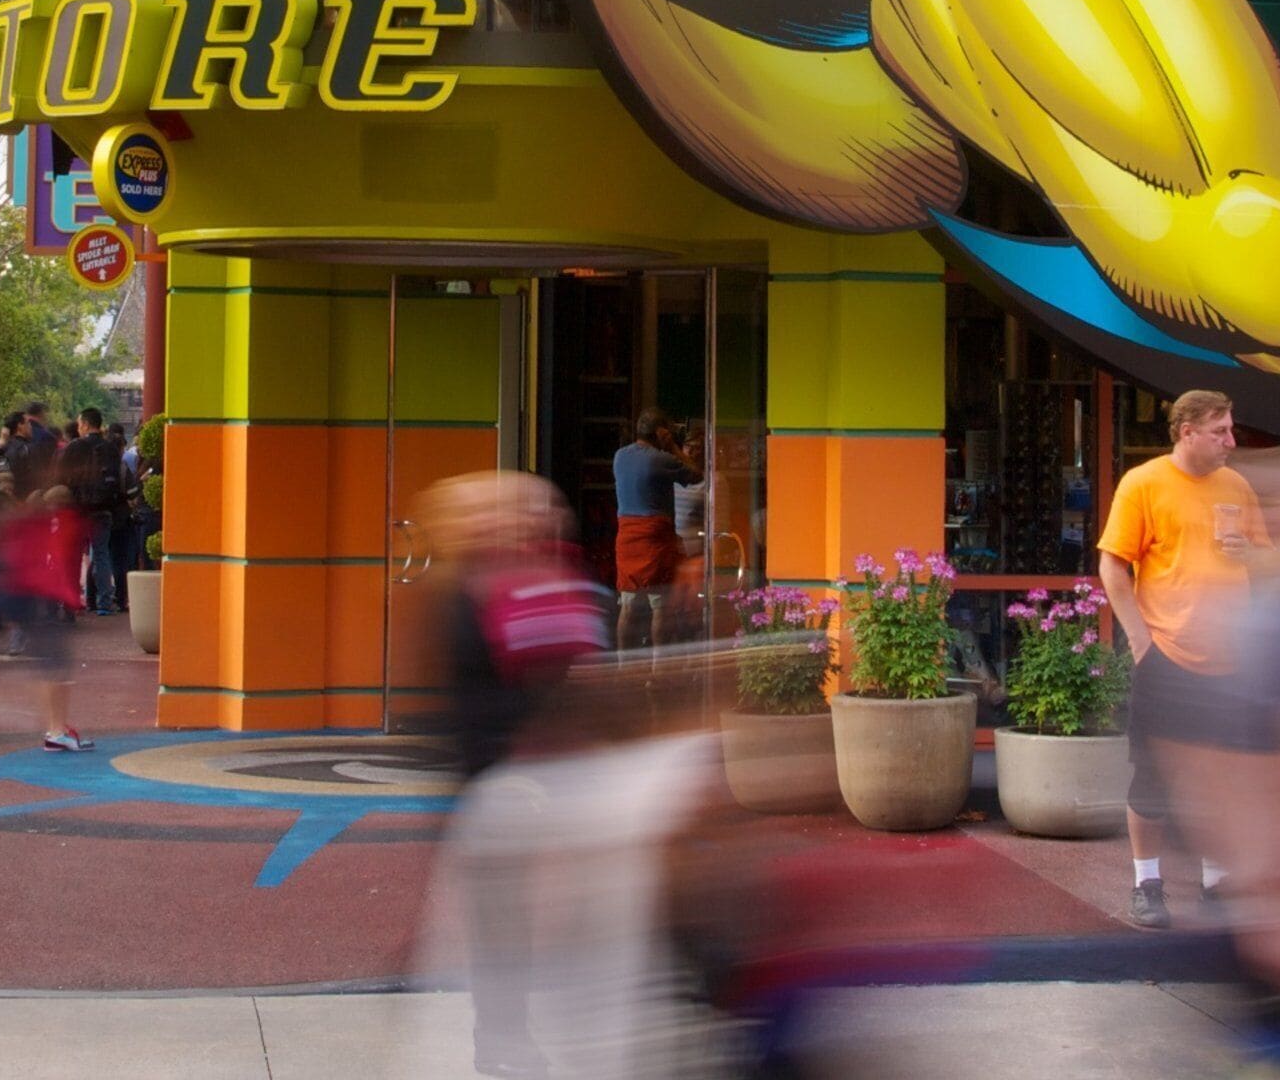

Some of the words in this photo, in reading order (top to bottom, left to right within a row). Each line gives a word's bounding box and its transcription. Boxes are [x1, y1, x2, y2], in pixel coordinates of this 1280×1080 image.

[122, 154, 161, 175] EXPRESS
[139, 169, 158, 182] PLUS
[121, 183, 141, 195] SOLD
[143, 185, 162, 196] HERE
